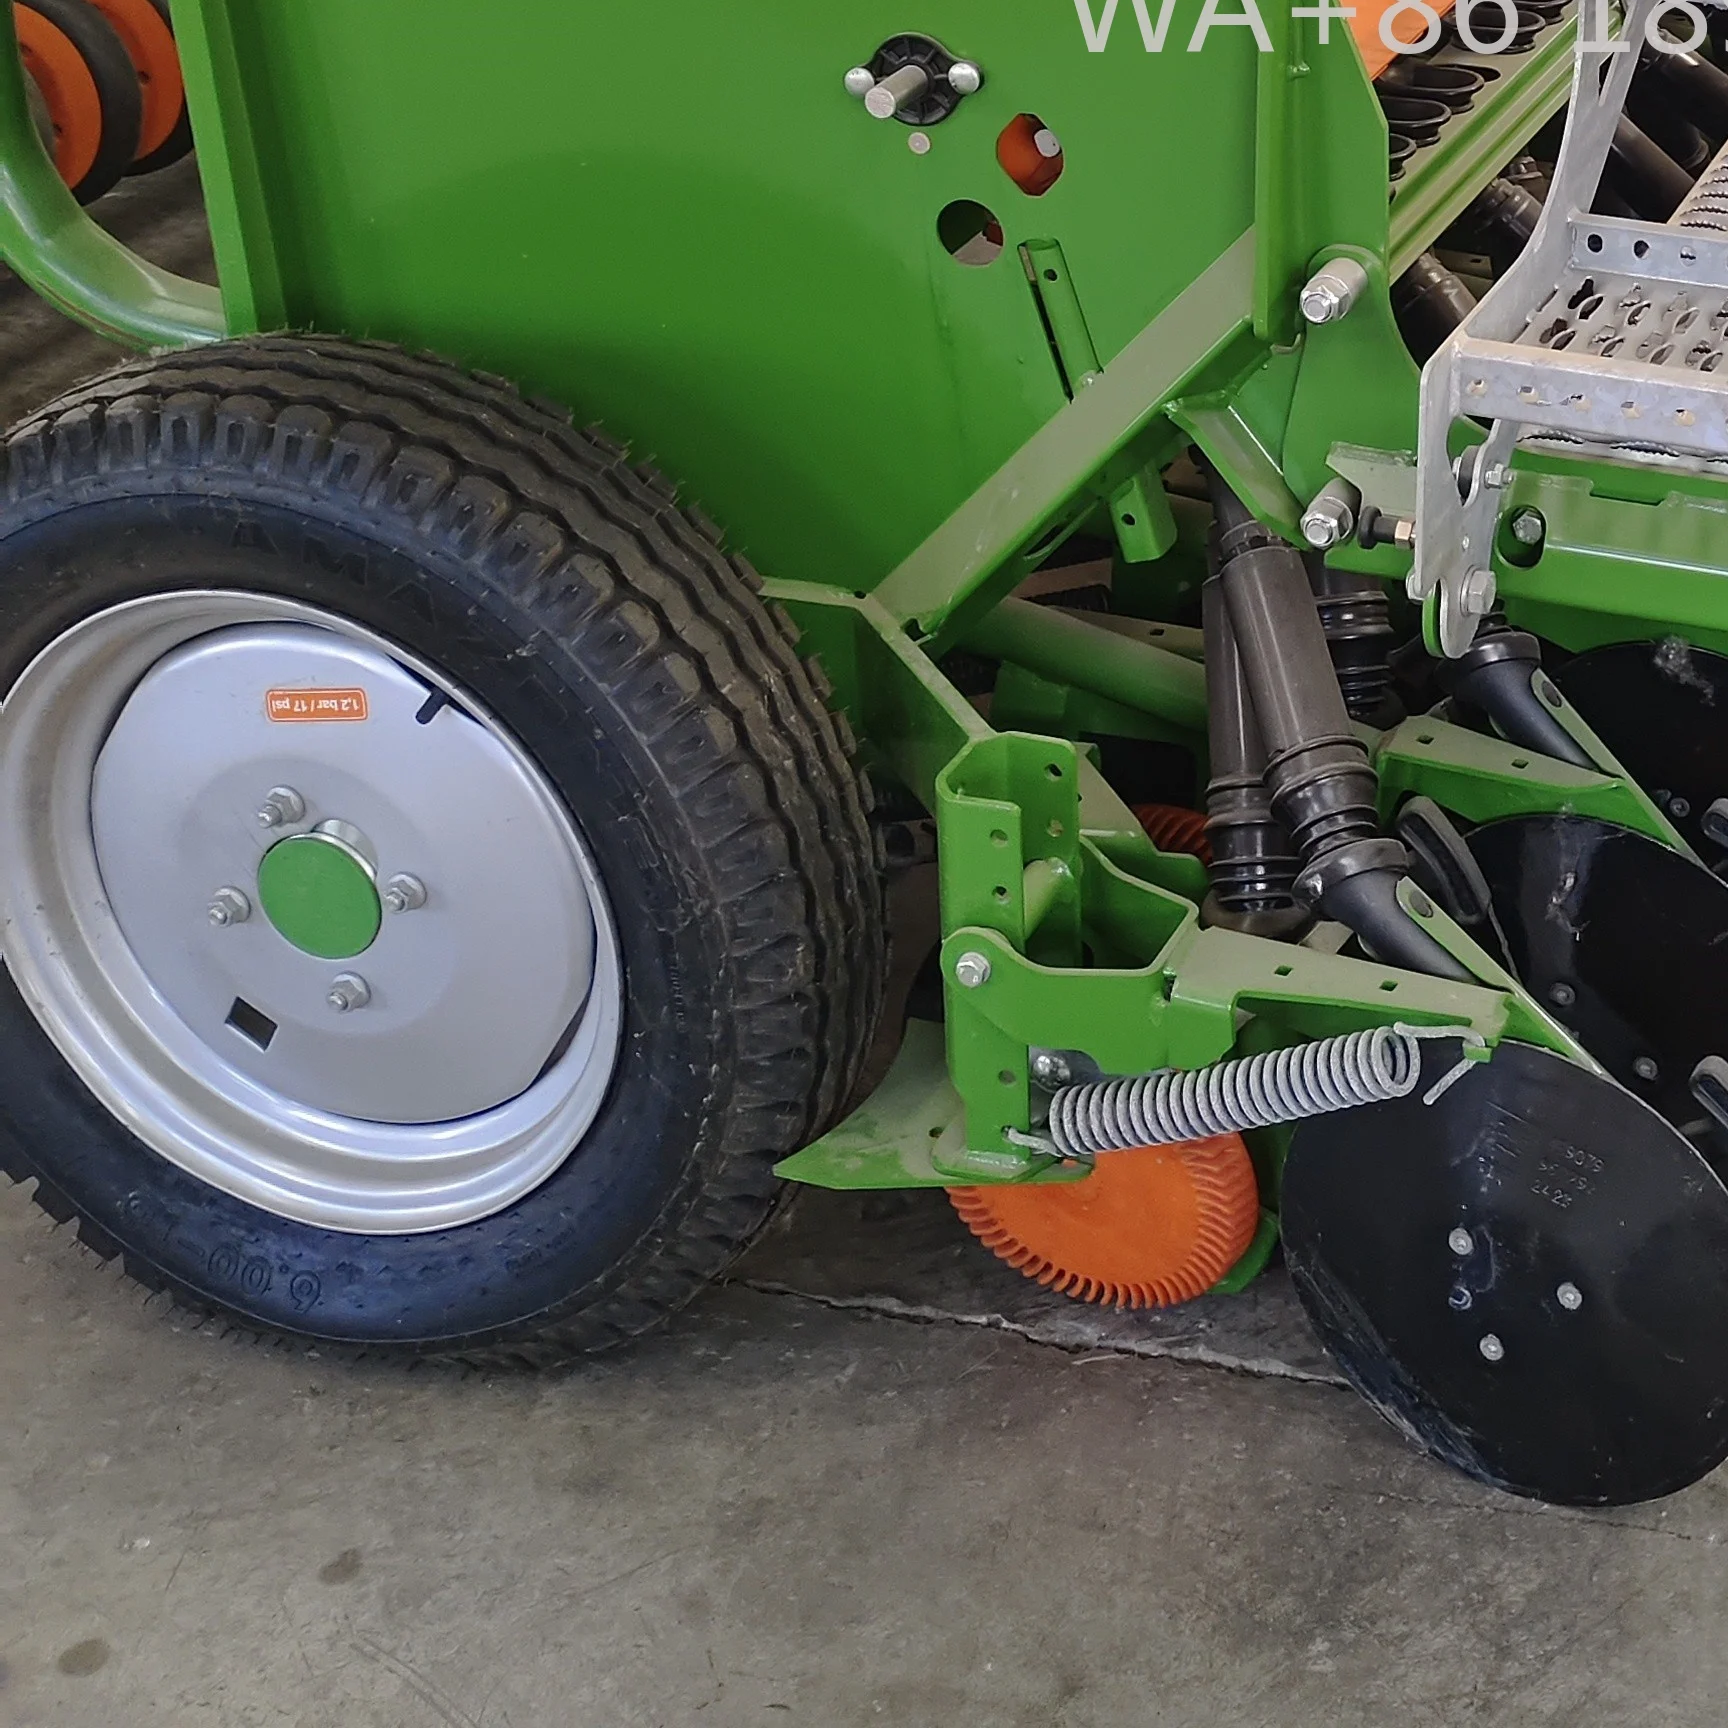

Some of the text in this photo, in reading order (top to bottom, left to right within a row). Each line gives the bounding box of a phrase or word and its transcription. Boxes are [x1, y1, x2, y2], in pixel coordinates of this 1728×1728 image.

[271, 697, 291, 713] psi
[293, 699, 308, 713] 17
[316, 699, 338, 712] bar
[340, 697, 360, 711] 1,2
